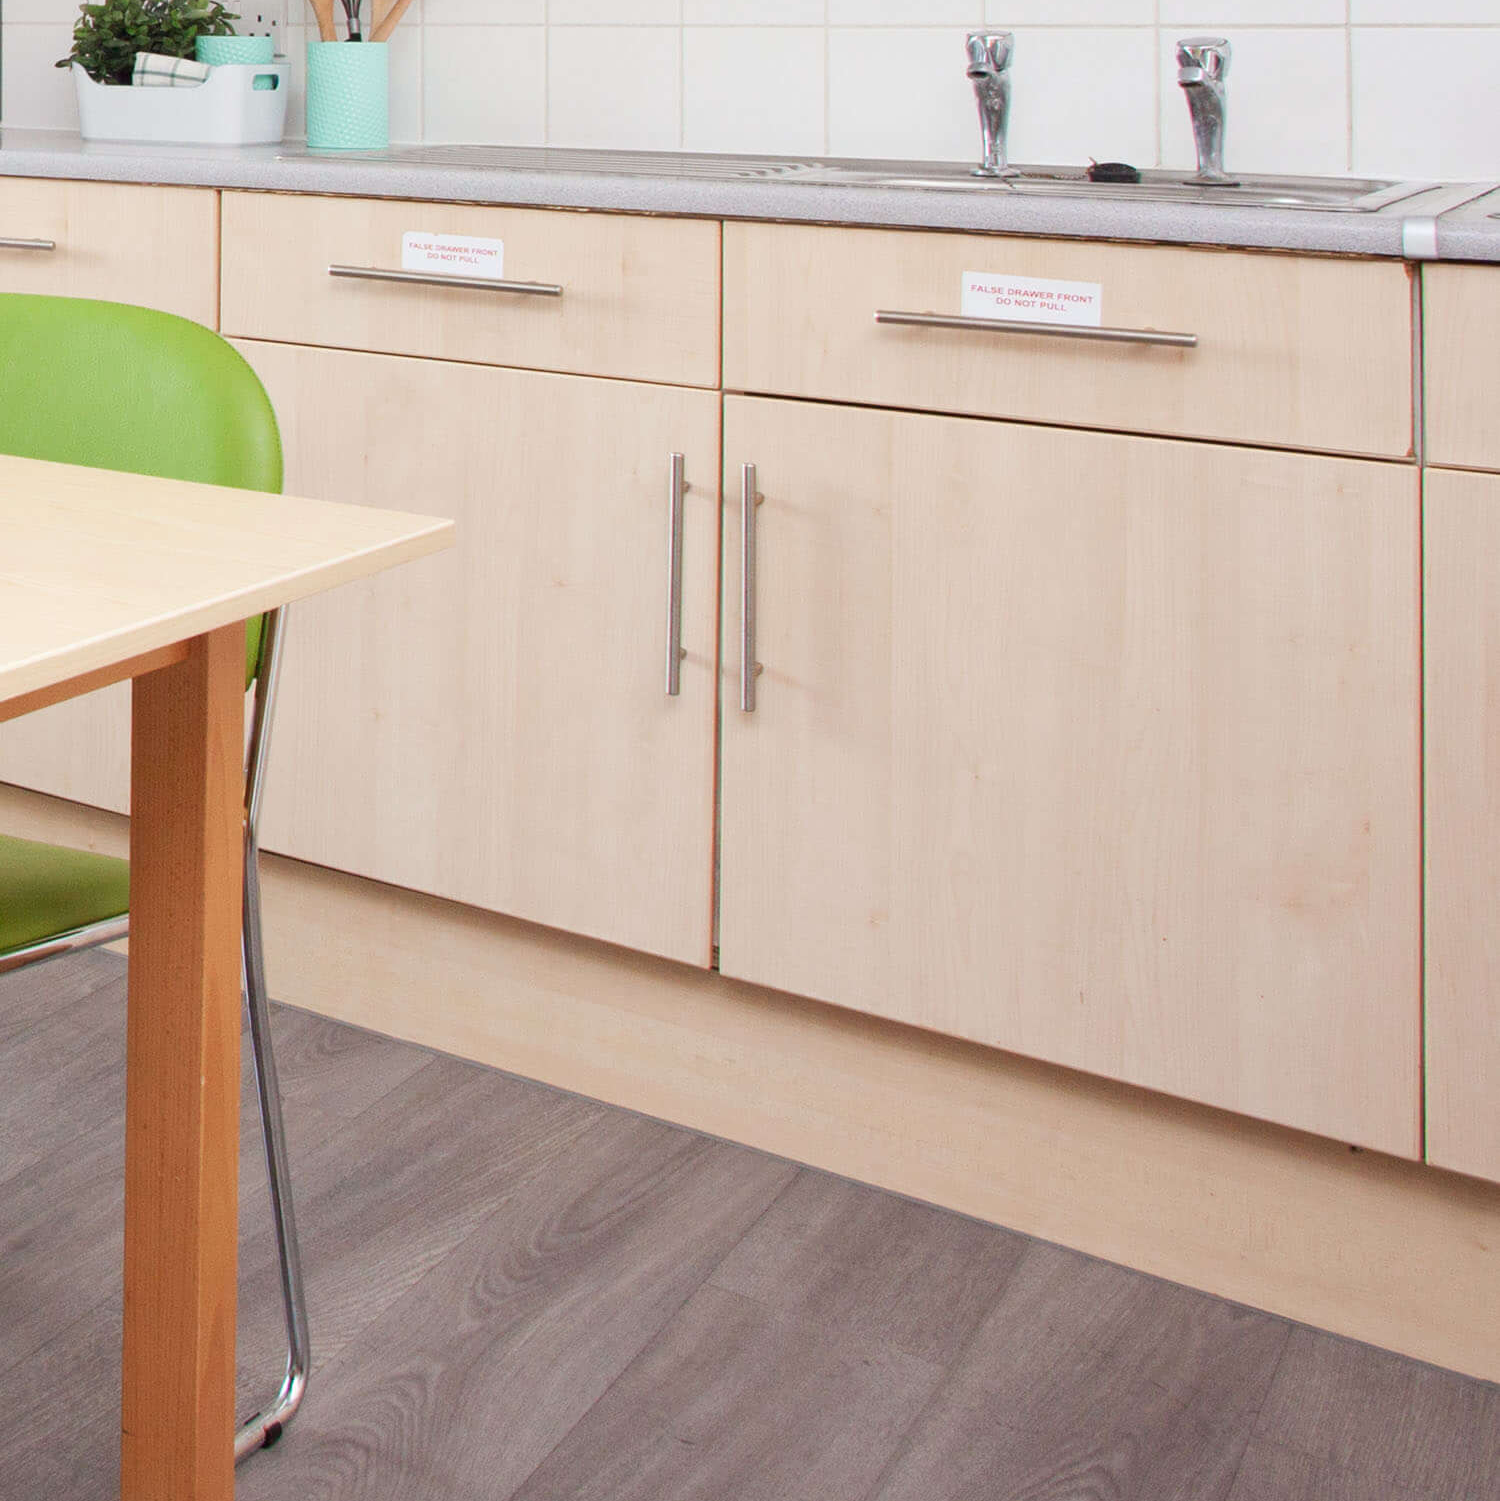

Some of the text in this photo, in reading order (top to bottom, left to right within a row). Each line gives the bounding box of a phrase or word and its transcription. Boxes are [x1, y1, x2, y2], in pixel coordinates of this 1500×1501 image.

[408, 242, 498, 256] FALSE DRAWER FRONT
[427, 252, 480, 264] DO NOT PULL
[970, 284, 1093, 303] FALSE DRAWER FRONT
[996, 297, 1067, 311] DO NOT PULL
